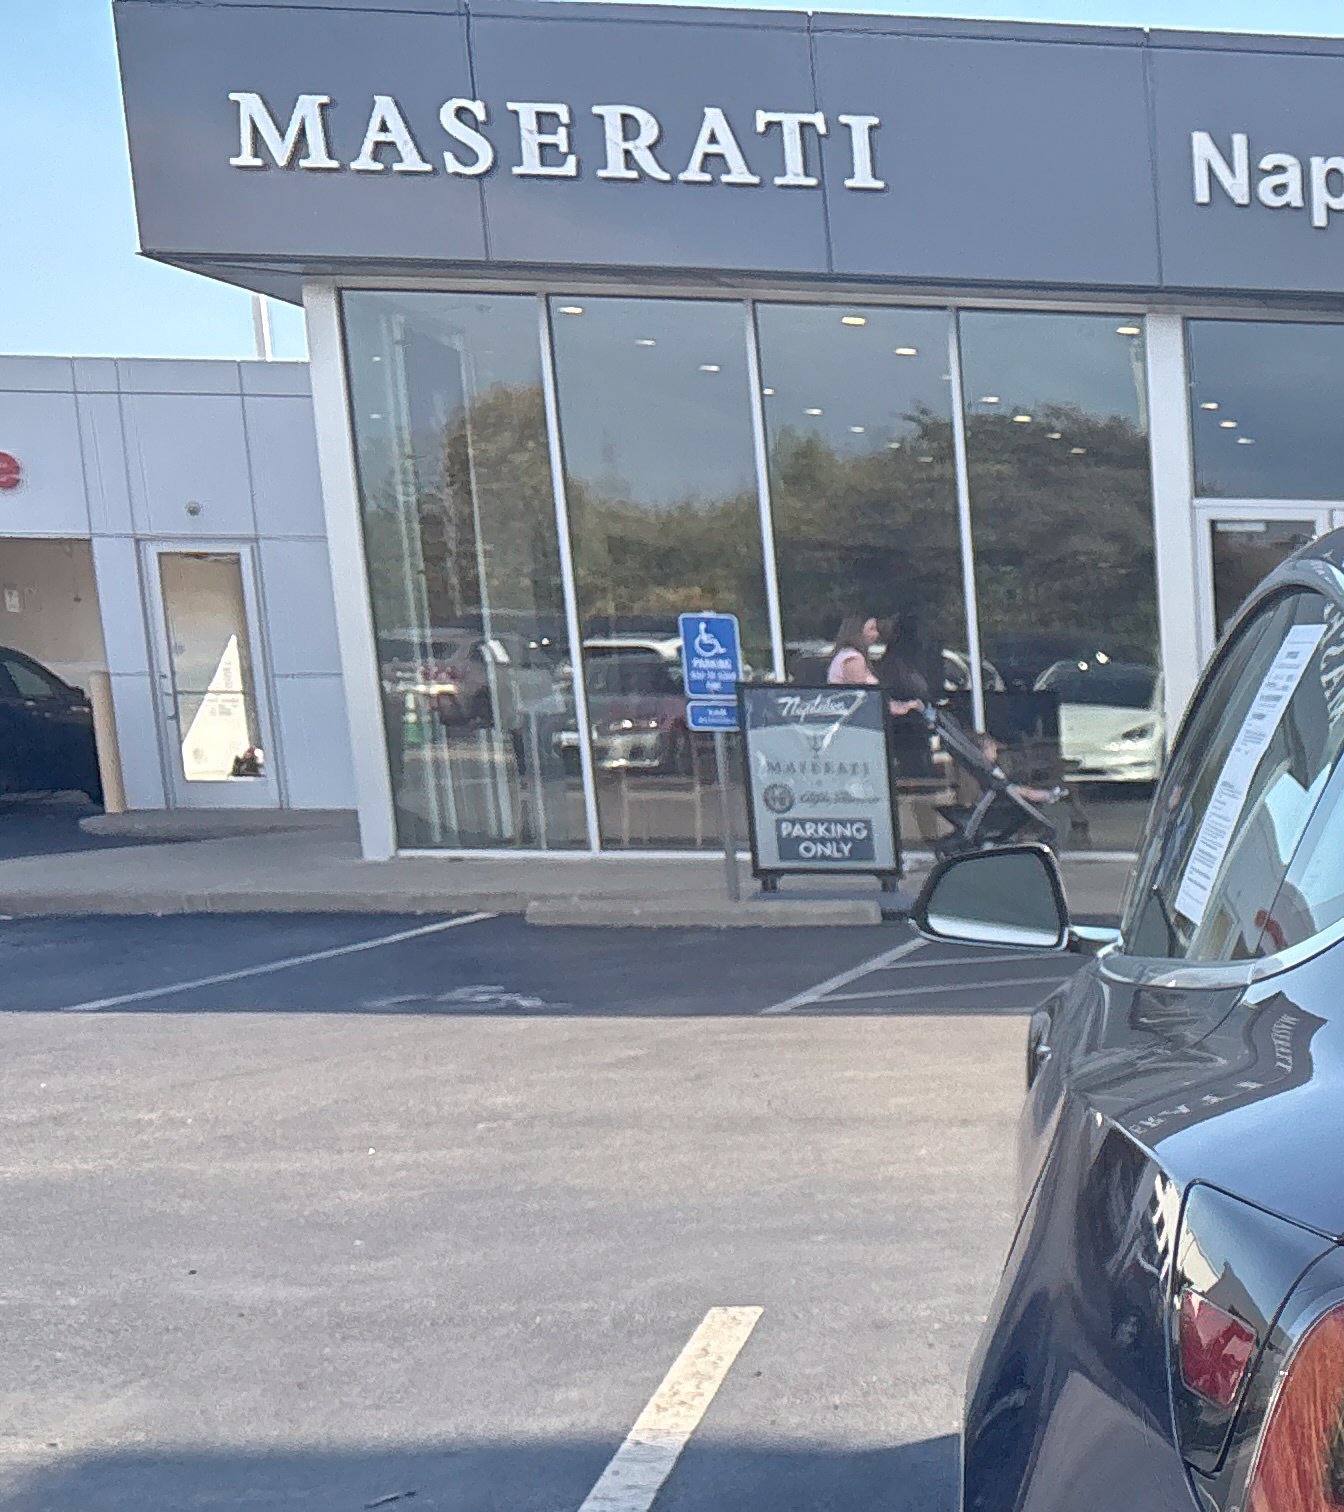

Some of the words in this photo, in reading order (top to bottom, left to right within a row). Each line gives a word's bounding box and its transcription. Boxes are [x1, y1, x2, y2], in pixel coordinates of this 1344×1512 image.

[228, 91, 889, 192] MASERATI
[781, 821, 868, 839] PARKING
[798, 841, 853, 859] ONLY
